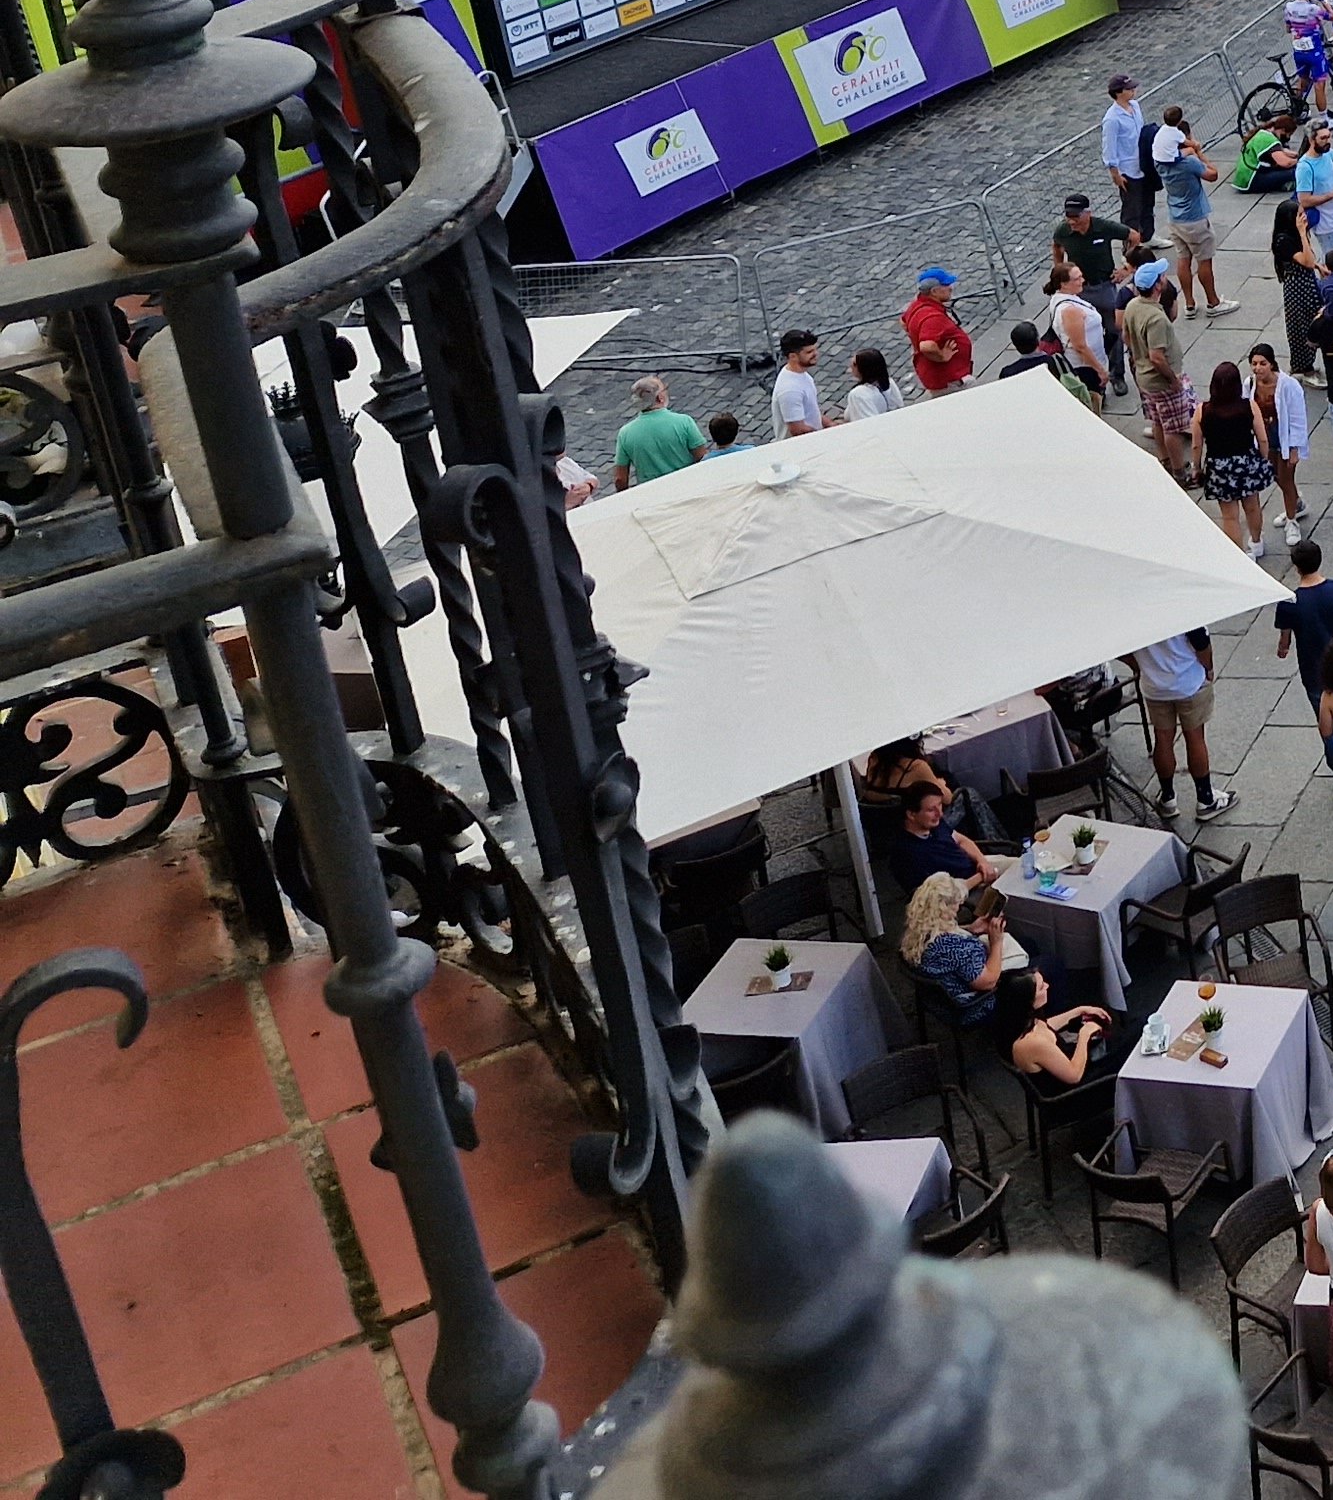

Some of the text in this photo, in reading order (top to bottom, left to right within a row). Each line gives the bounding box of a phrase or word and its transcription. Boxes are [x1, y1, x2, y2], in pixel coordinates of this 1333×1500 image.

[830, 58, 900, 97] CERATIZIT
[836, 70, 907, 108] CHALLENGE
[644, 146, 698, 176] CERATIZIT
[648, 155, 702, 184] CHALLENGE
